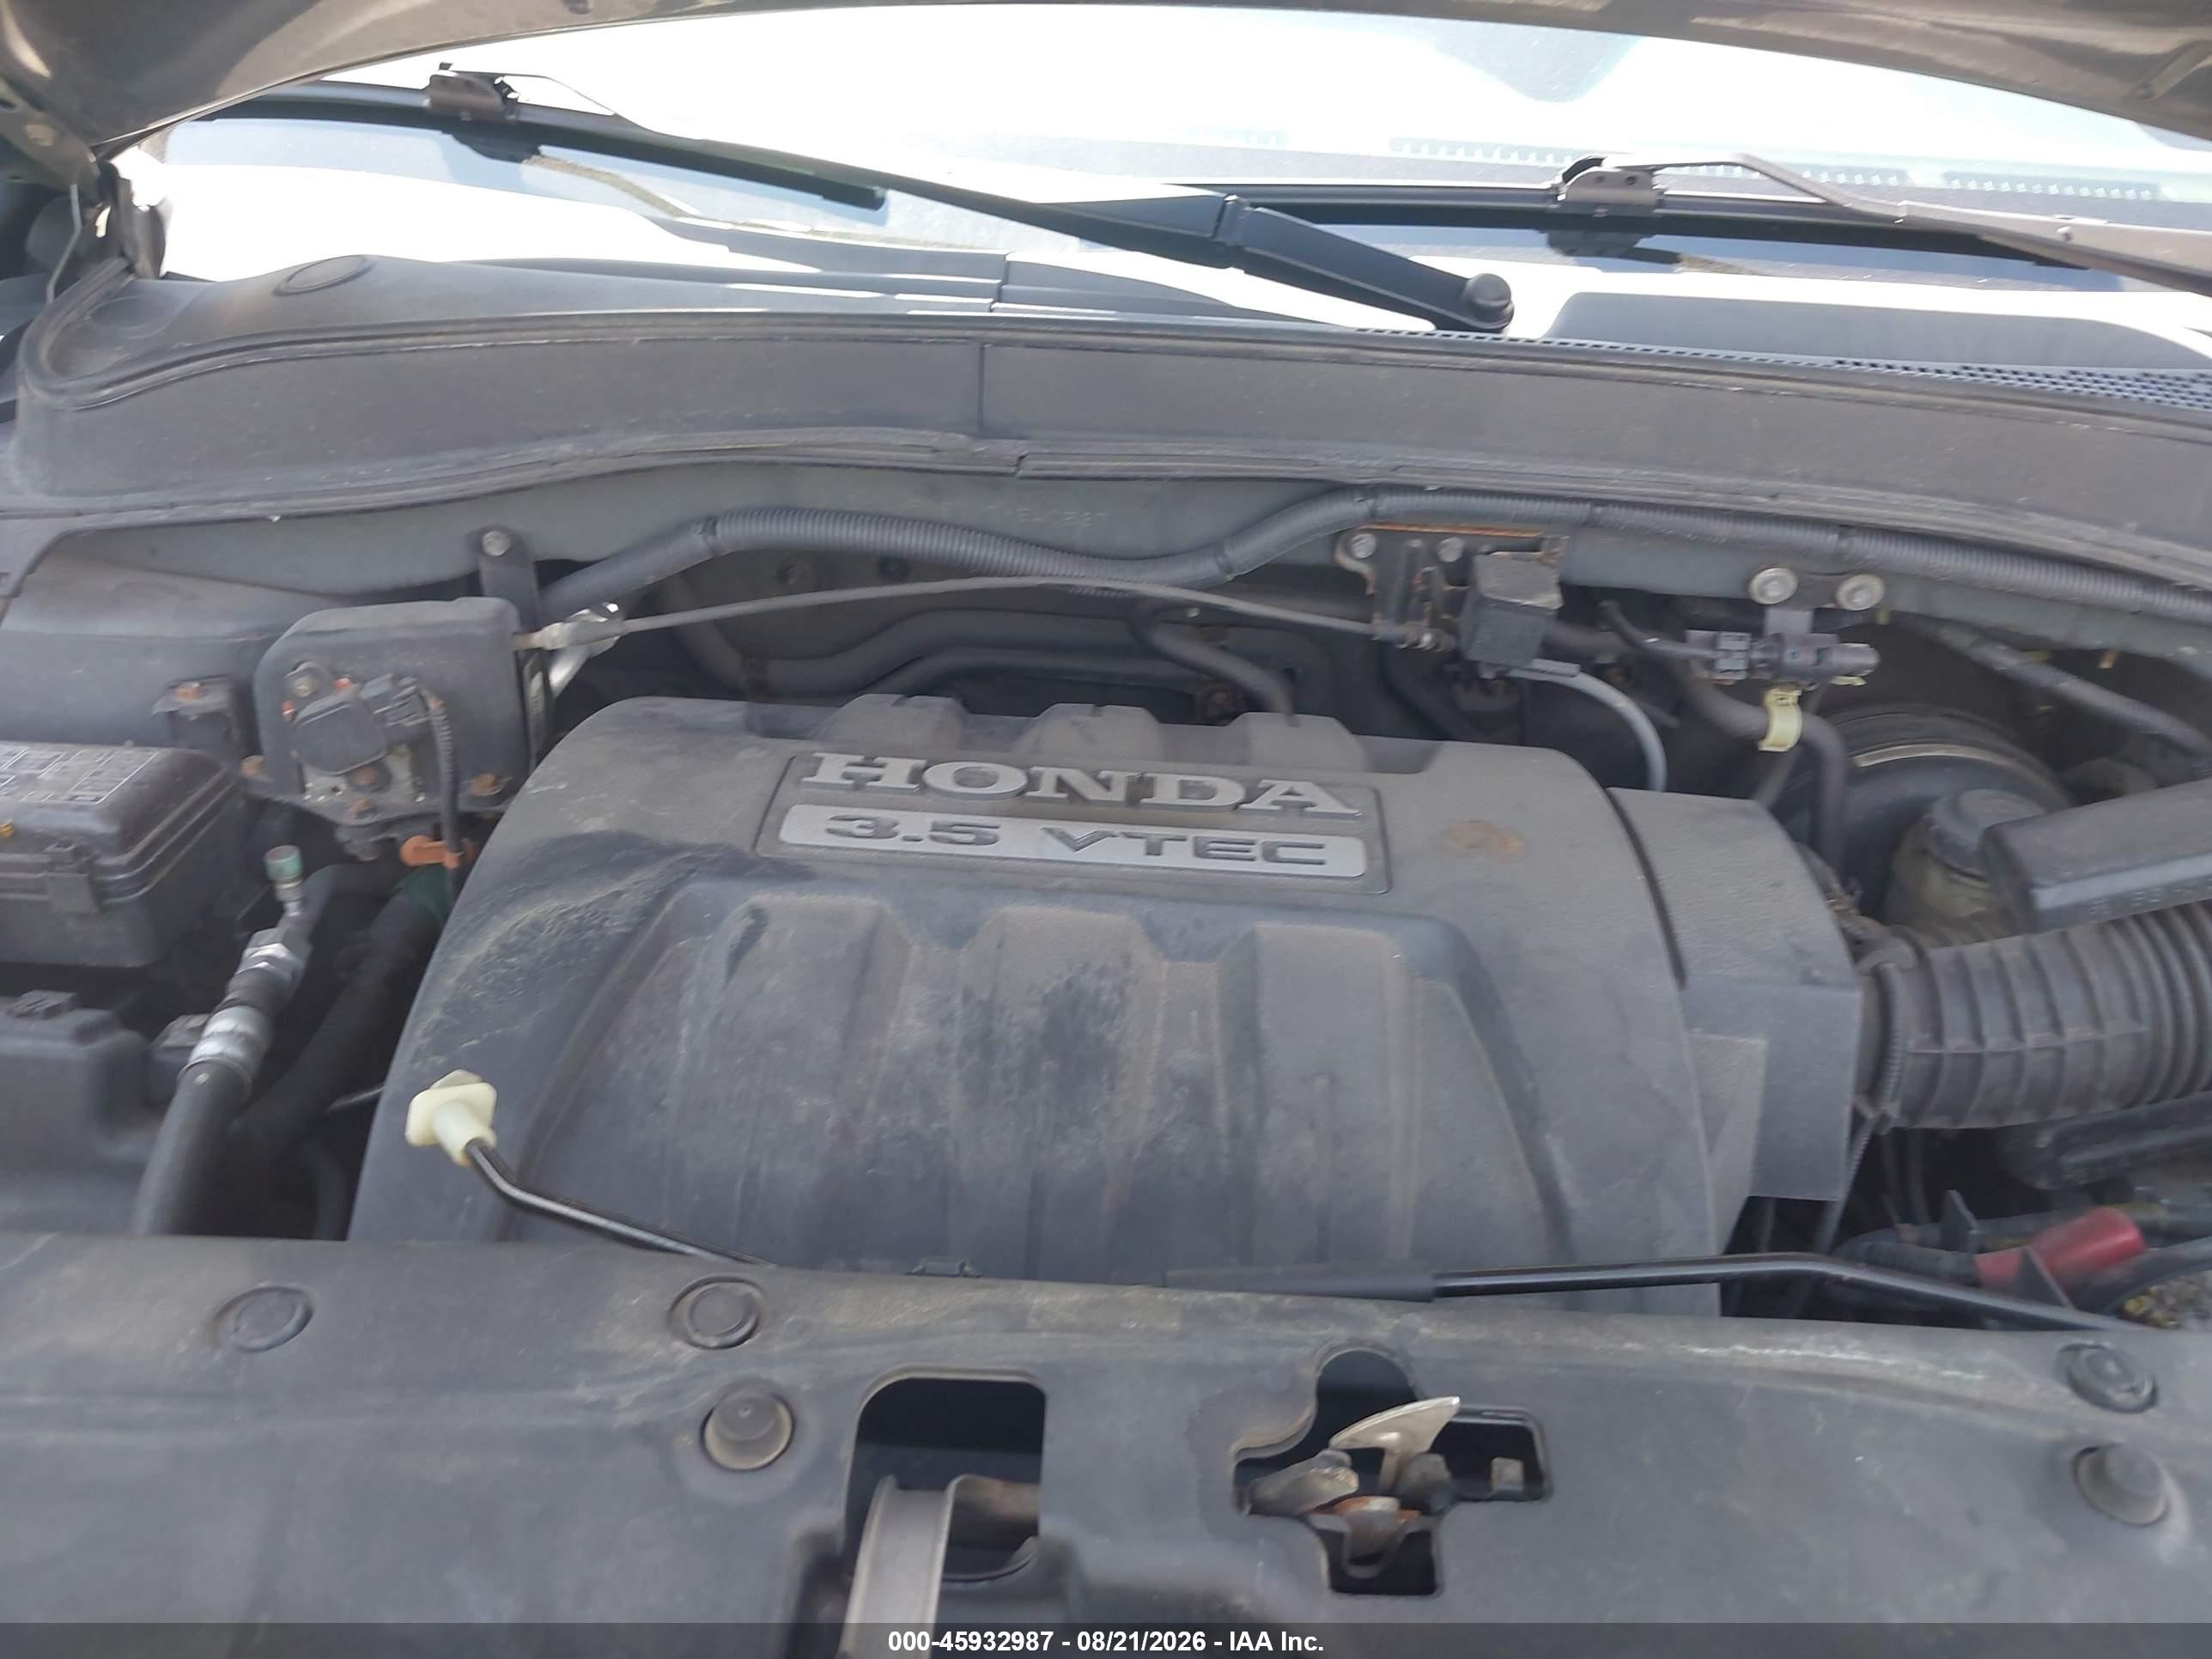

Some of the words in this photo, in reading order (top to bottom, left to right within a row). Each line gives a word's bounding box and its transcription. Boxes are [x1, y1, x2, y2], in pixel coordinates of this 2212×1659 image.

[800, 751, 1363, 820] HONDA
[824, 814, 1000, 846] 3.5
[1041, 827, 1327, 866] VTEC
